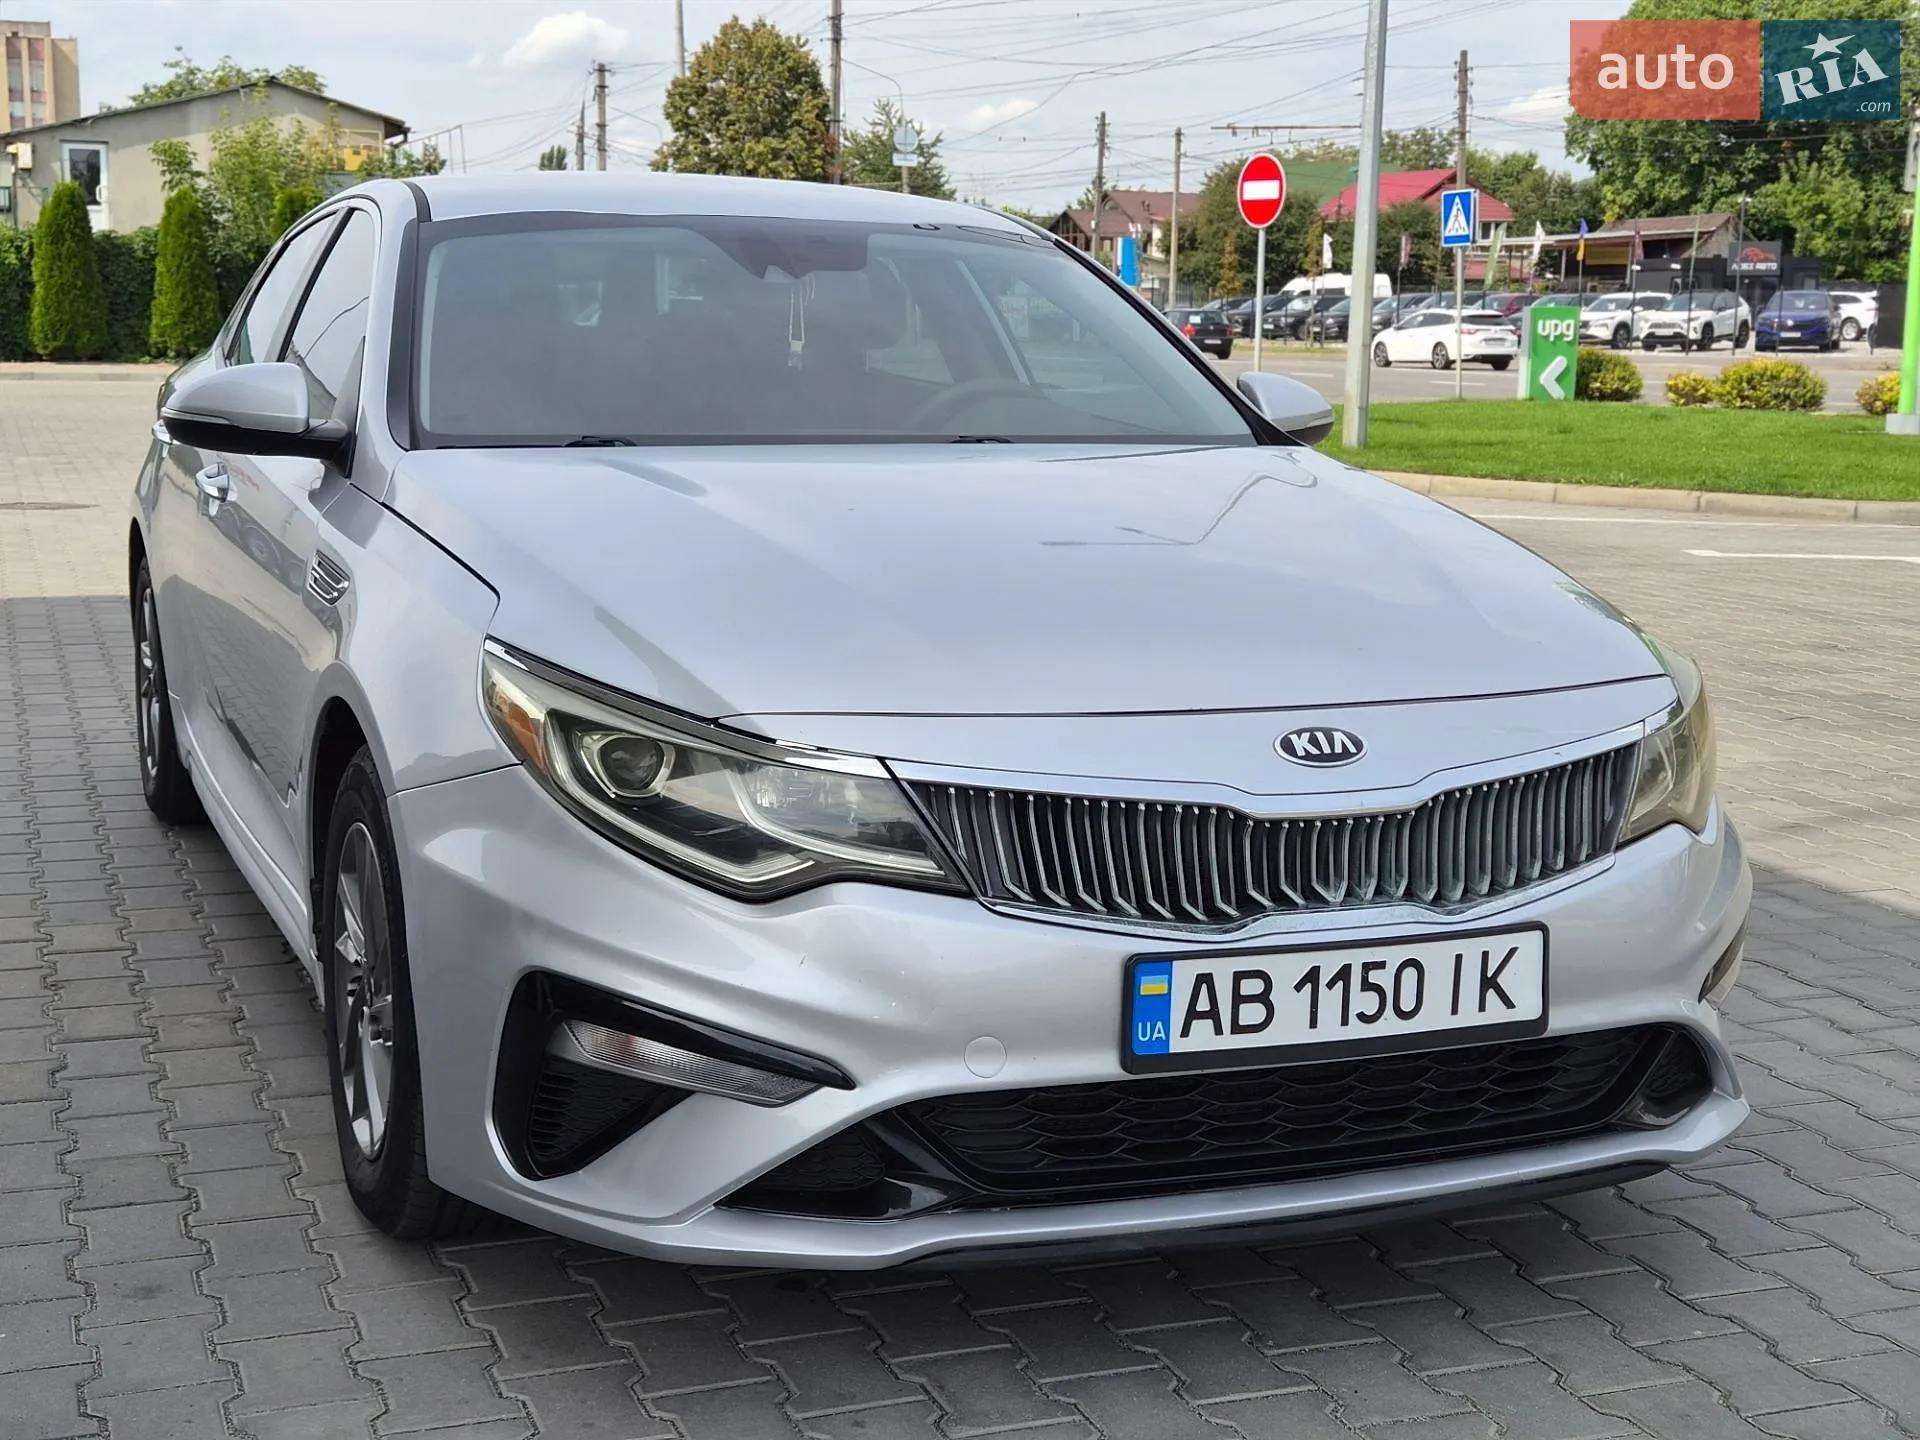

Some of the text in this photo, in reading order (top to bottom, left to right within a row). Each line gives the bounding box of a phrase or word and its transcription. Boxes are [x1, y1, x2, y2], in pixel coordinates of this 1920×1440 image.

[1537, 319, 1575, 342] upg
[1286, 729, 1360, 758] KIA
[1179, 946, 1520, 1039] AB 1150 IK
[1137, 1020, 1167, 1042] UA
